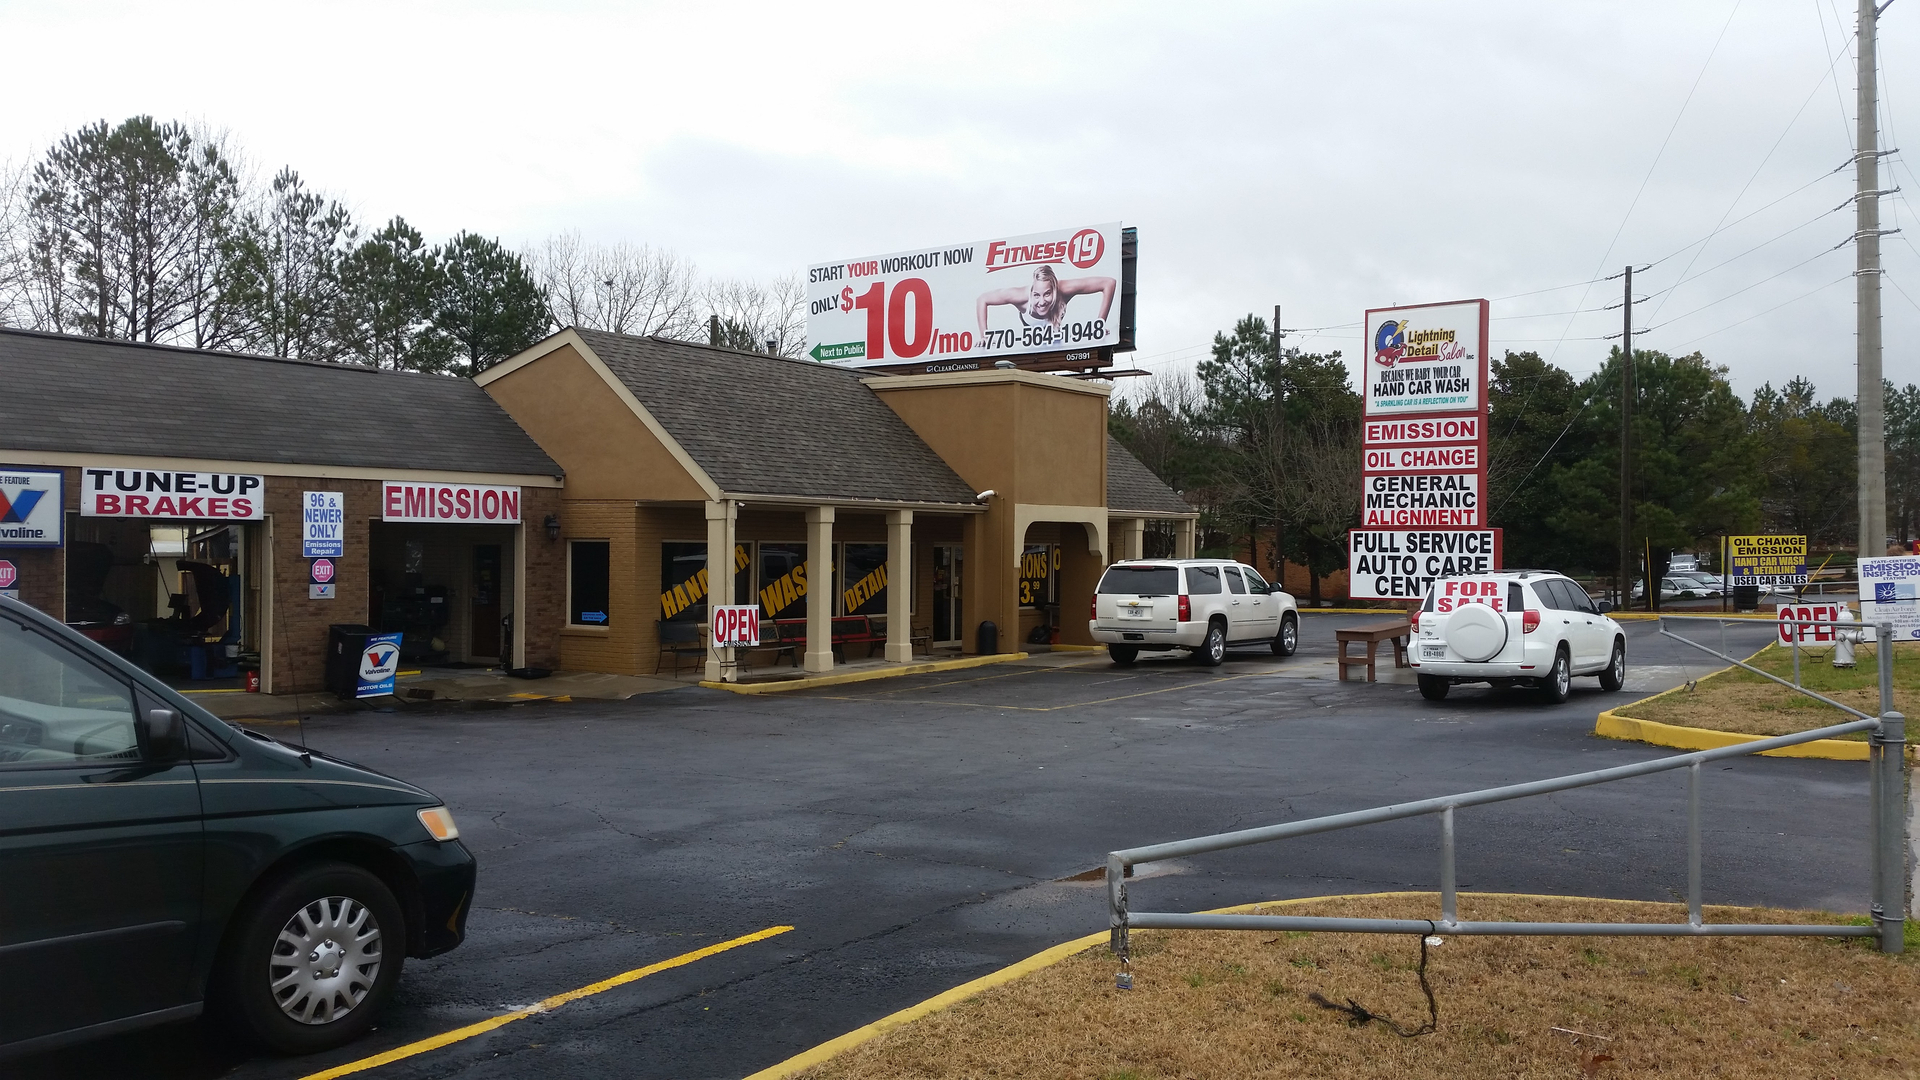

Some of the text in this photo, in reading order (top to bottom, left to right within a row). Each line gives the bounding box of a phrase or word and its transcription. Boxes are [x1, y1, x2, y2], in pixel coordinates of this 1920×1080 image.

[1073, 233, 1099, 263] 19
[810, 247, 973, 283] START YOUR WORKOUT NOW
[811, 294, 839, 315] ONLY
[985, 320, 1104, 349] 770-564-1948
[1408, 328, 1455, 345] Lightning
[821, 345, 864, 357] Next to Publix
[1408, 344, 1438, 356] Detail
[1438, 341, 1466, 361] Salon
[1381, 365, 1461, 382] BECAUSE WE BABY YOUR CAR
[1374, 378, 1469, 397] HAND CAR WASH
[1380, 399, 1403, 407] SPARKLING
[1422, 397, 1449, 405] REFLECTION
[1368, 421, 1475, 440] EMISSION
[1368, 449, 1475, 467] OIL CHANGE
[4, 476, 30, 485] FEATURE
[87, 469, 259, 495] TUNE-UP
[1373, 476, 1470, 492] GENERAL
[96, 494, 253, 518] BRAKES
[310, 493, 336, 507] 96 &
[386, 486, 518, 520] EMISSION
[1367, 492, 1475, 508] MECHANIC
[305, 508, 342, 523] NEWER
[1368, 509, 1475, 525] ALIGNMENT
[0, 527, 43, 538] voline
[310, 524, 337, 538] ONLY
[1354, 533, 1492, 553] FULL SERVICE
[1734, 537, 1805, 546] OIL CHANGE
[1738, 546, 1802, 555] EMISSION
[1356, 555, 1488, 576] AUTO CARE
[1734, 556, 1805, 566] HAND CAR WASH
[315, 565, 331, 575] EXIT
[1753, 566, 1796, 575] DETAILING
[1863, 570, 1920, 578] INSPECTIO
[1375, 576, 1435, 596] CENT
[1734, 575, 1806, 585] USED CAR SALES
[759, 560, 808, 618] WAS
[1446, 581, 1497, 596] FOR
[1438, 598, 1503, 613] SAE
[715, 609, 758, 643] OPEN
[365, 667, 391, 675] Valvoline
